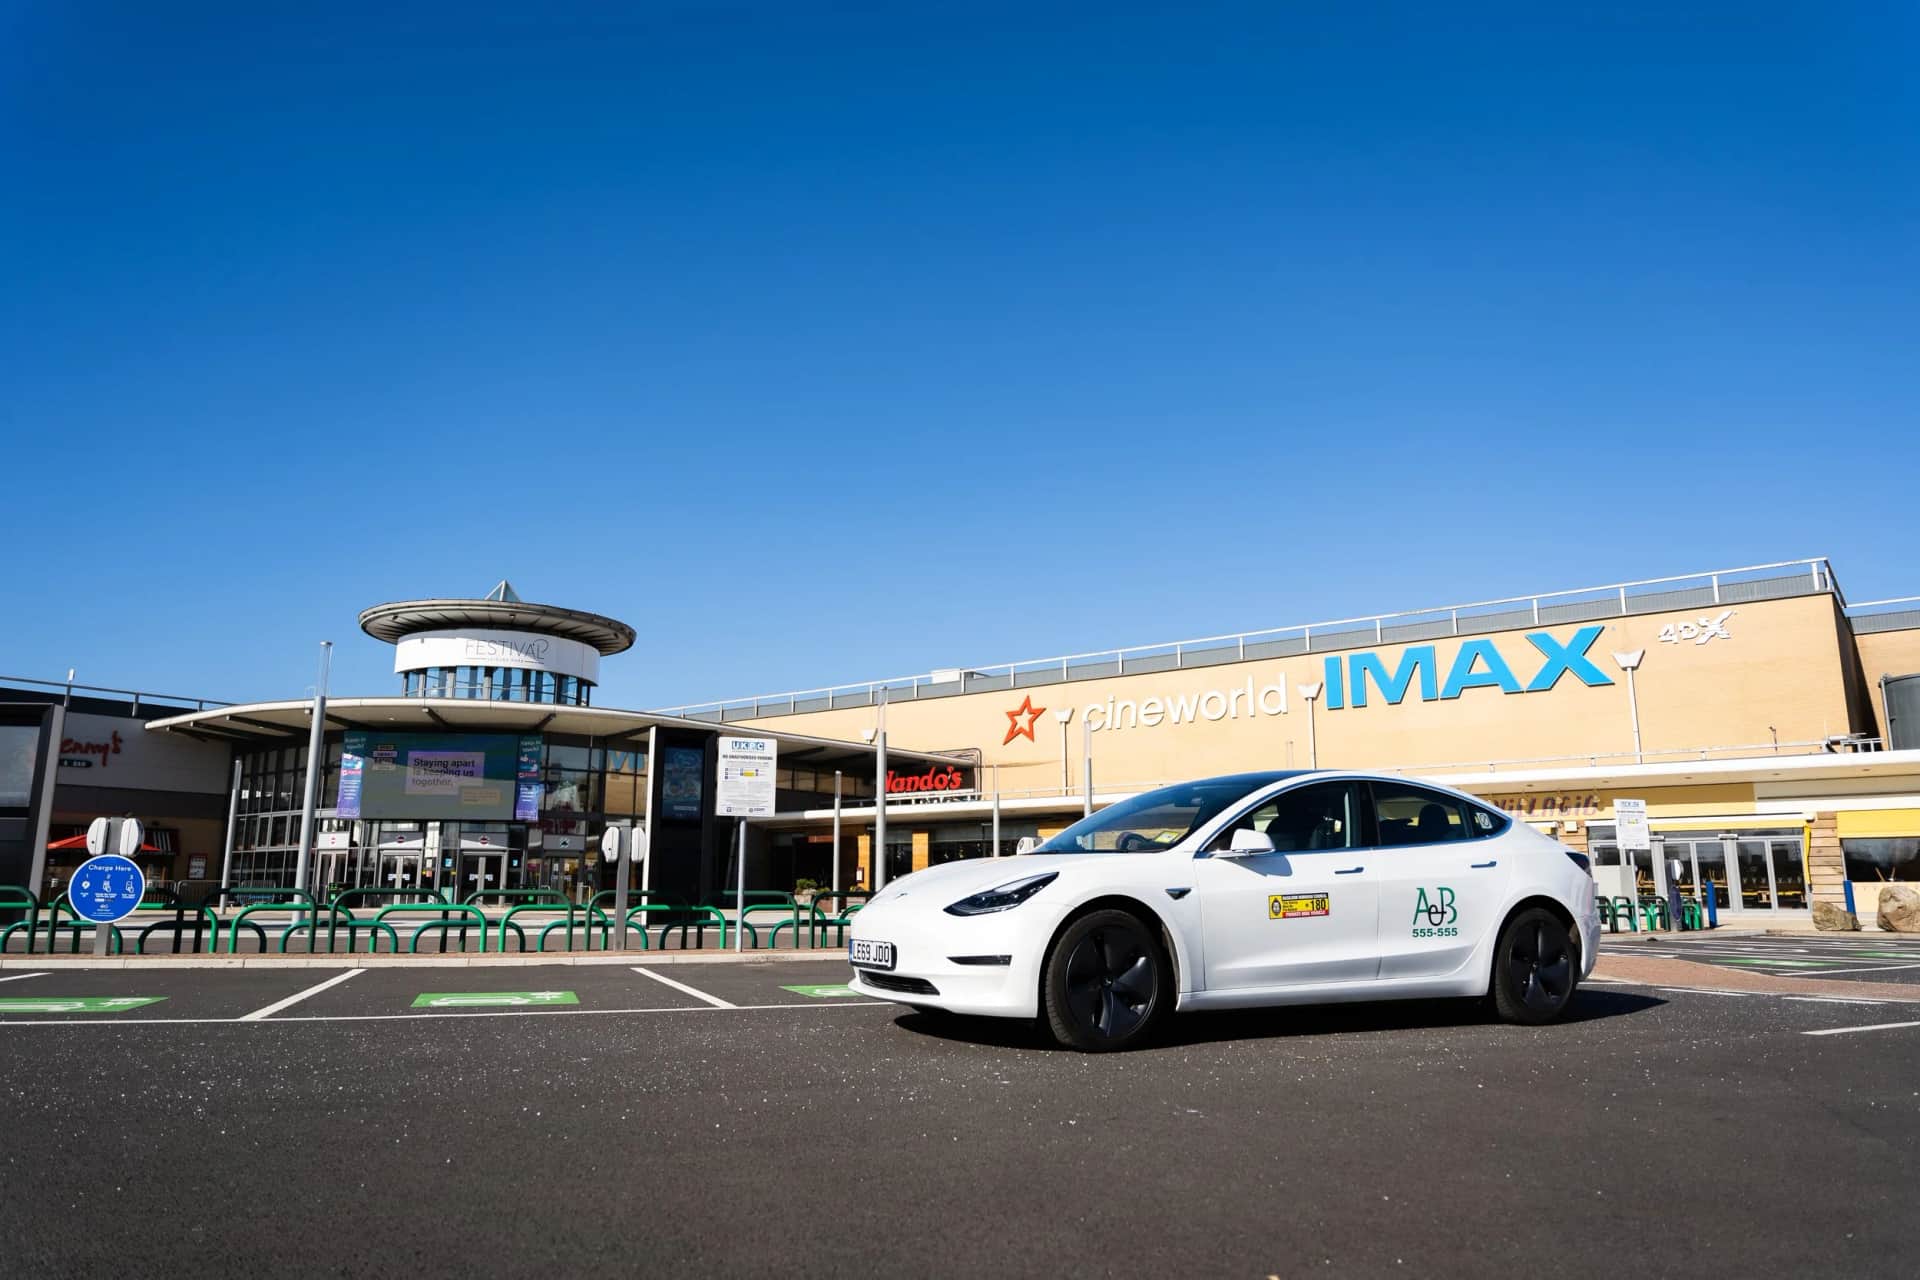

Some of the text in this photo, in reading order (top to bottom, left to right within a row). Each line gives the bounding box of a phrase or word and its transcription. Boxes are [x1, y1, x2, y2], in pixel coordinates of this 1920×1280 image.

[1658, 610, 1734, 645] 4DX
[465, 638, 549, 660] FESTIVAL
[1324, 625, 1616, 710] IMAX
[1082, 672, 1288, 732] cineworld
[414, 758, 475, 768] Staying apart
[88, 864, 132, 872] Charge Here
[1309, 898, 1326, 911] 180
[1412, 927, 1458, 938] 555-555
